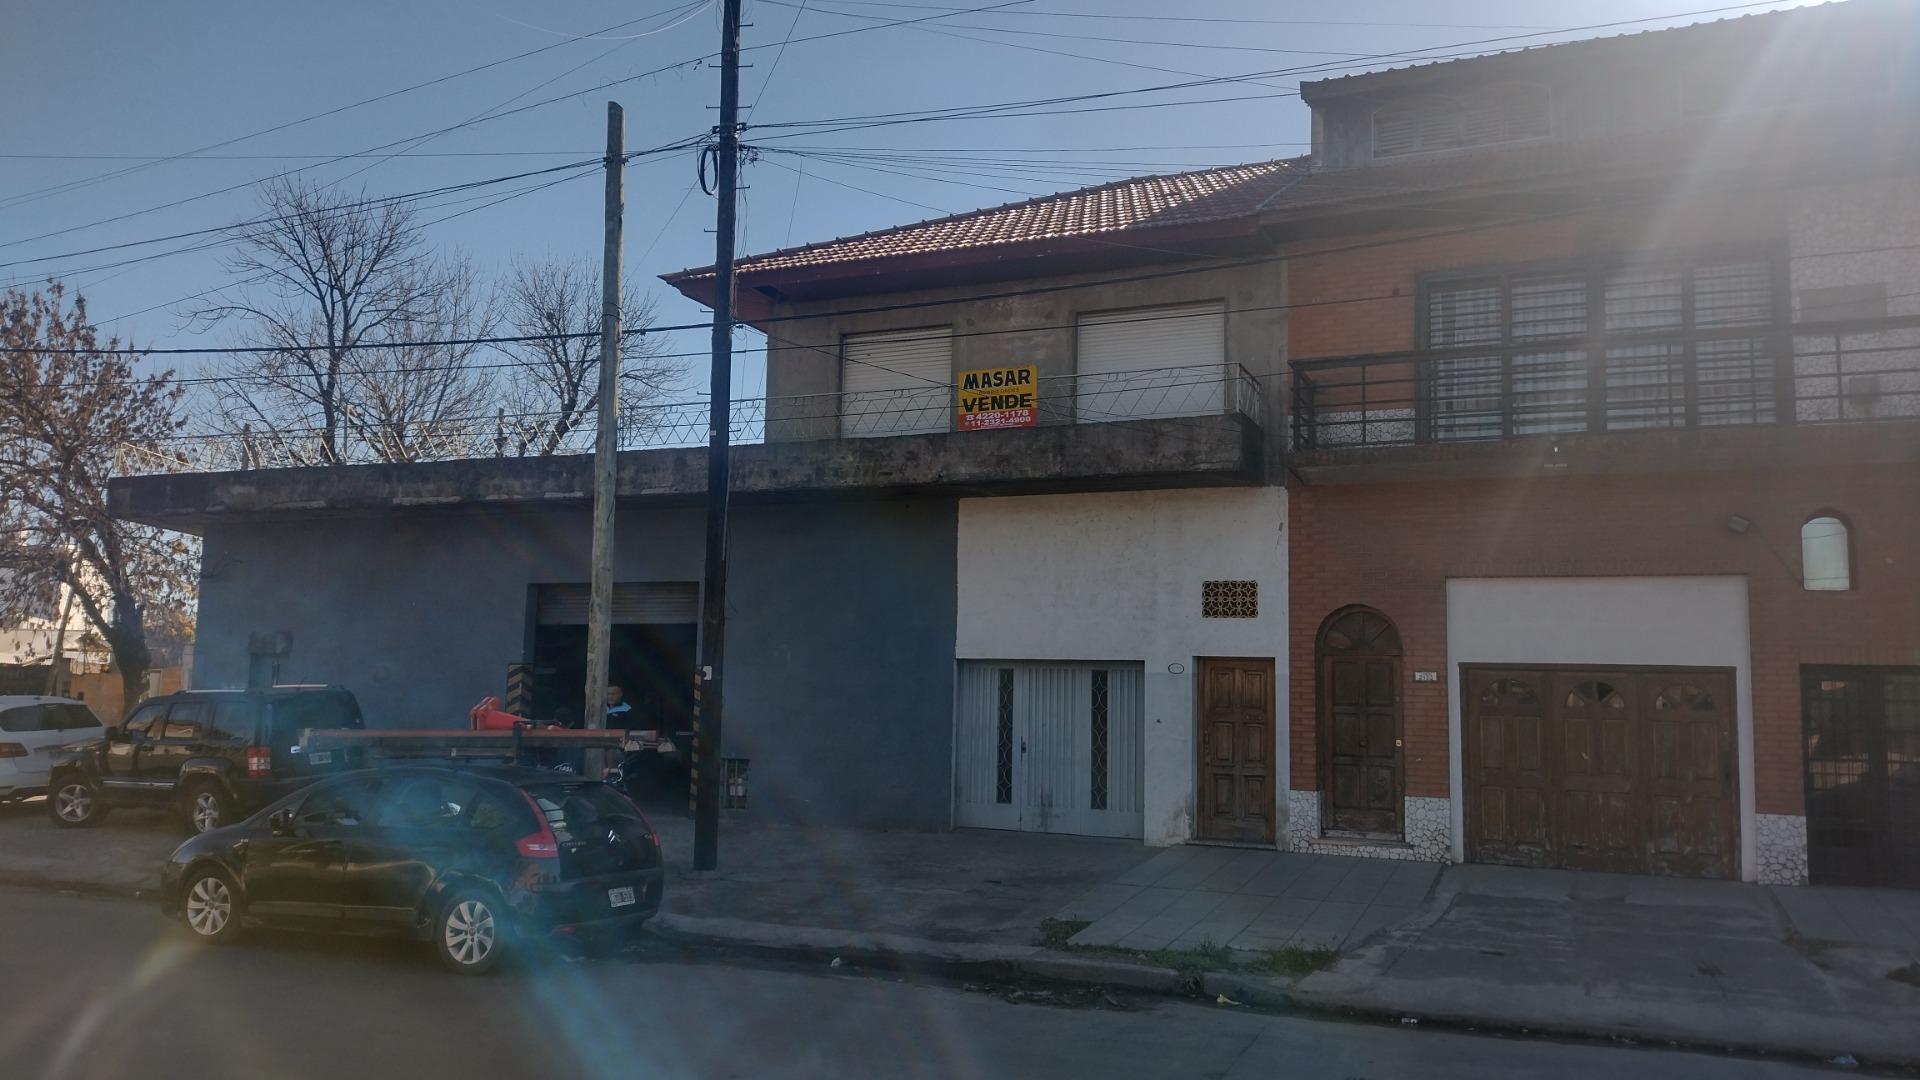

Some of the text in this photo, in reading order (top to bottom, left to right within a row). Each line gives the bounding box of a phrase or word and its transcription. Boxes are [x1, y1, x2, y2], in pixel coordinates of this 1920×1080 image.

[963, 369, 1031, 390] MASAR
[962, 393, 1033, 413] VENDE
[975, 410, 1029, 421] 4220-1178
